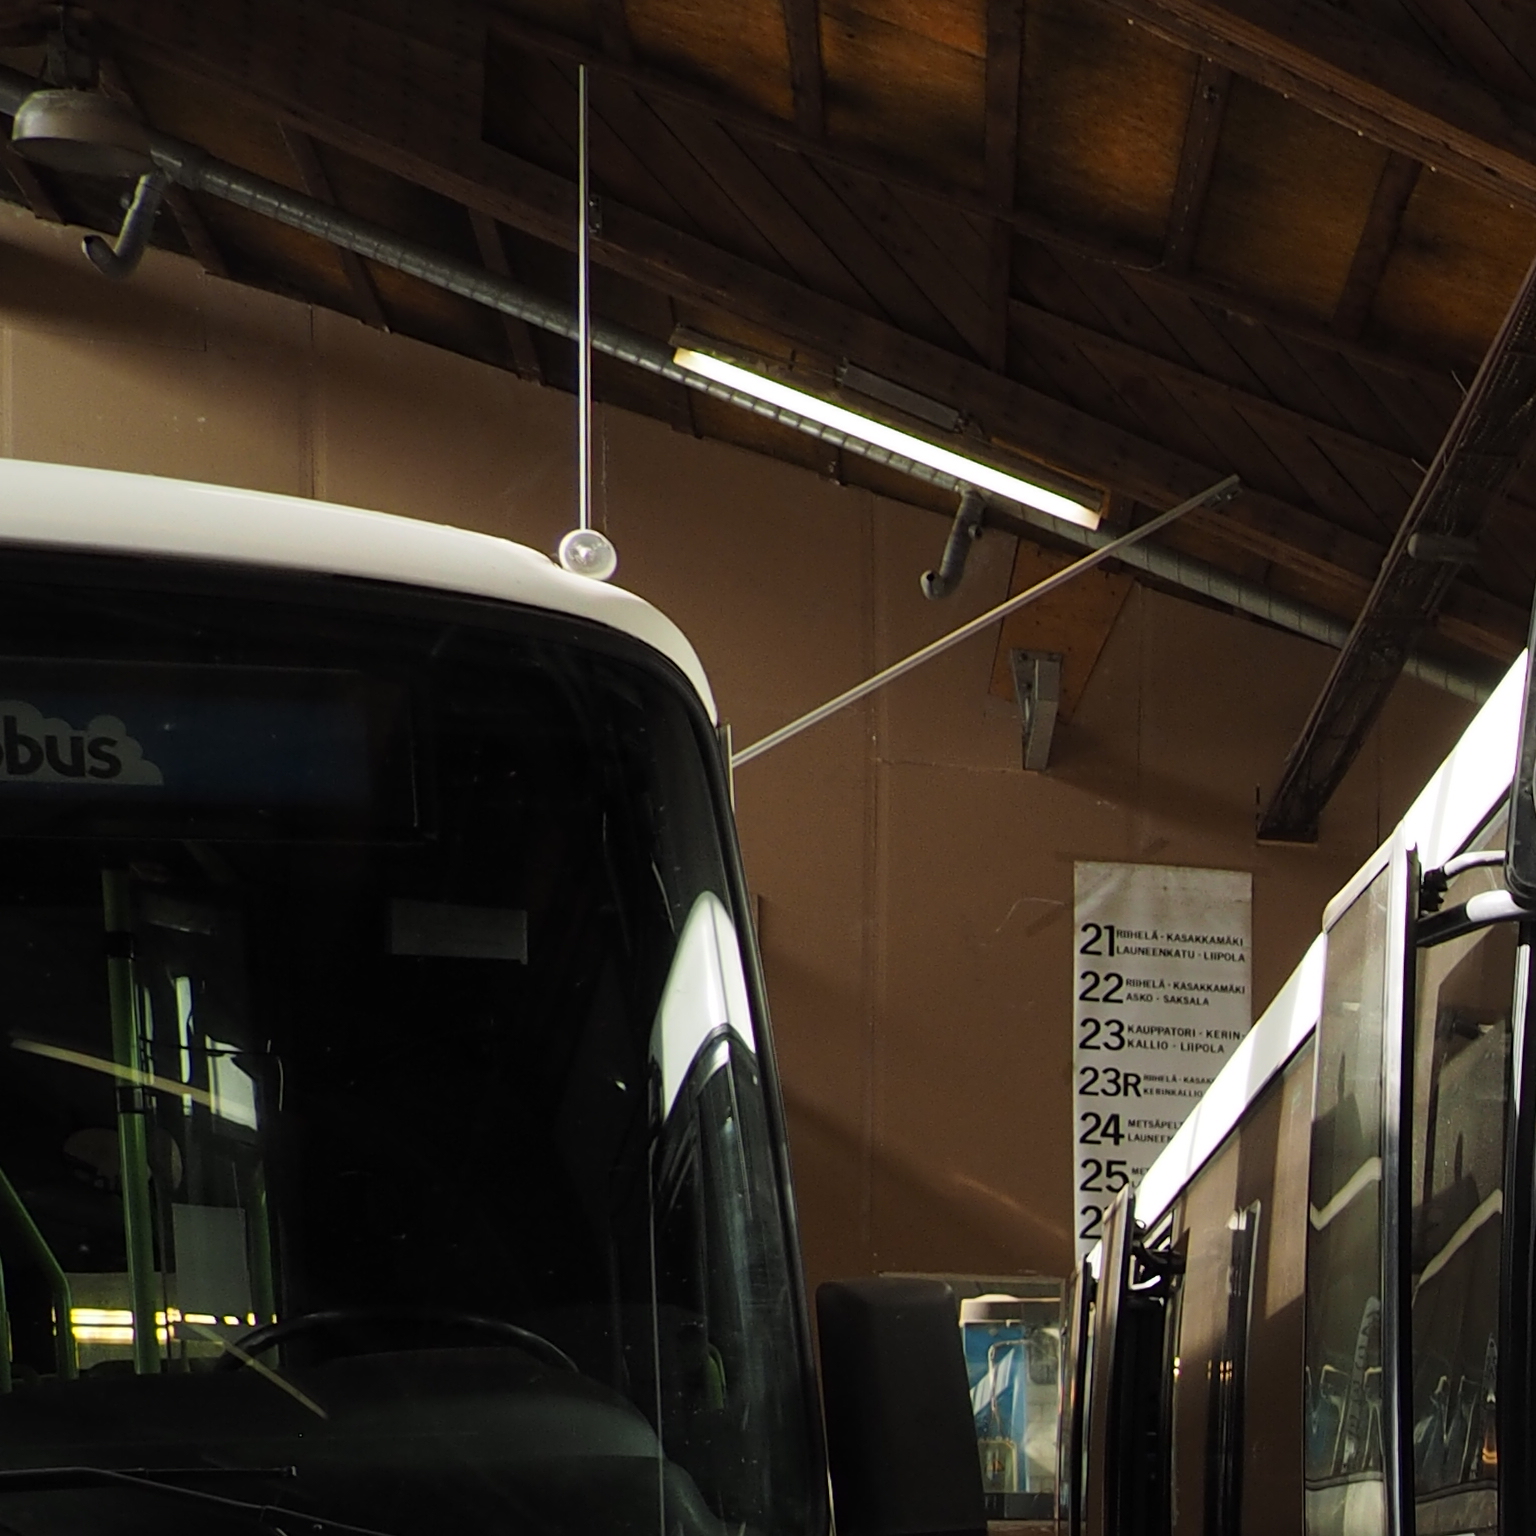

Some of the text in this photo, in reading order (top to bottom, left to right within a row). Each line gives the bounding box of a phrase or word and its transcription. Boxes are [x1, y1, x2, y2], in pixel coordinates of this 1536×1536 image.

[1080, 923, 1115, 957] 21
[1116, 929, 1243, 946] RIIHELÄ KASAKKAMÄKI
[1116, 946, 1245, 962] LAUNEENKATU LIIPOLA
[1079, 971, 1123, 1003] 22
[1126, 978, 1245, 994] RIIHELÄ KASAKKAMÄKI
[1126, 993, 1209, 1005] ASKO SAKSALA
[1079, 1018, 1125, 1050] 23
[1127, 1024, 1196, 1037] KAUPPATORI
[1127, 1039, 1225, 1053] KALLIO LIIPOLA
[1078, 1066, 1142, 1097] 23R
[1080, 1111, 1124, 1145] 24
[1080, 1158, 1129, 1193] 25
